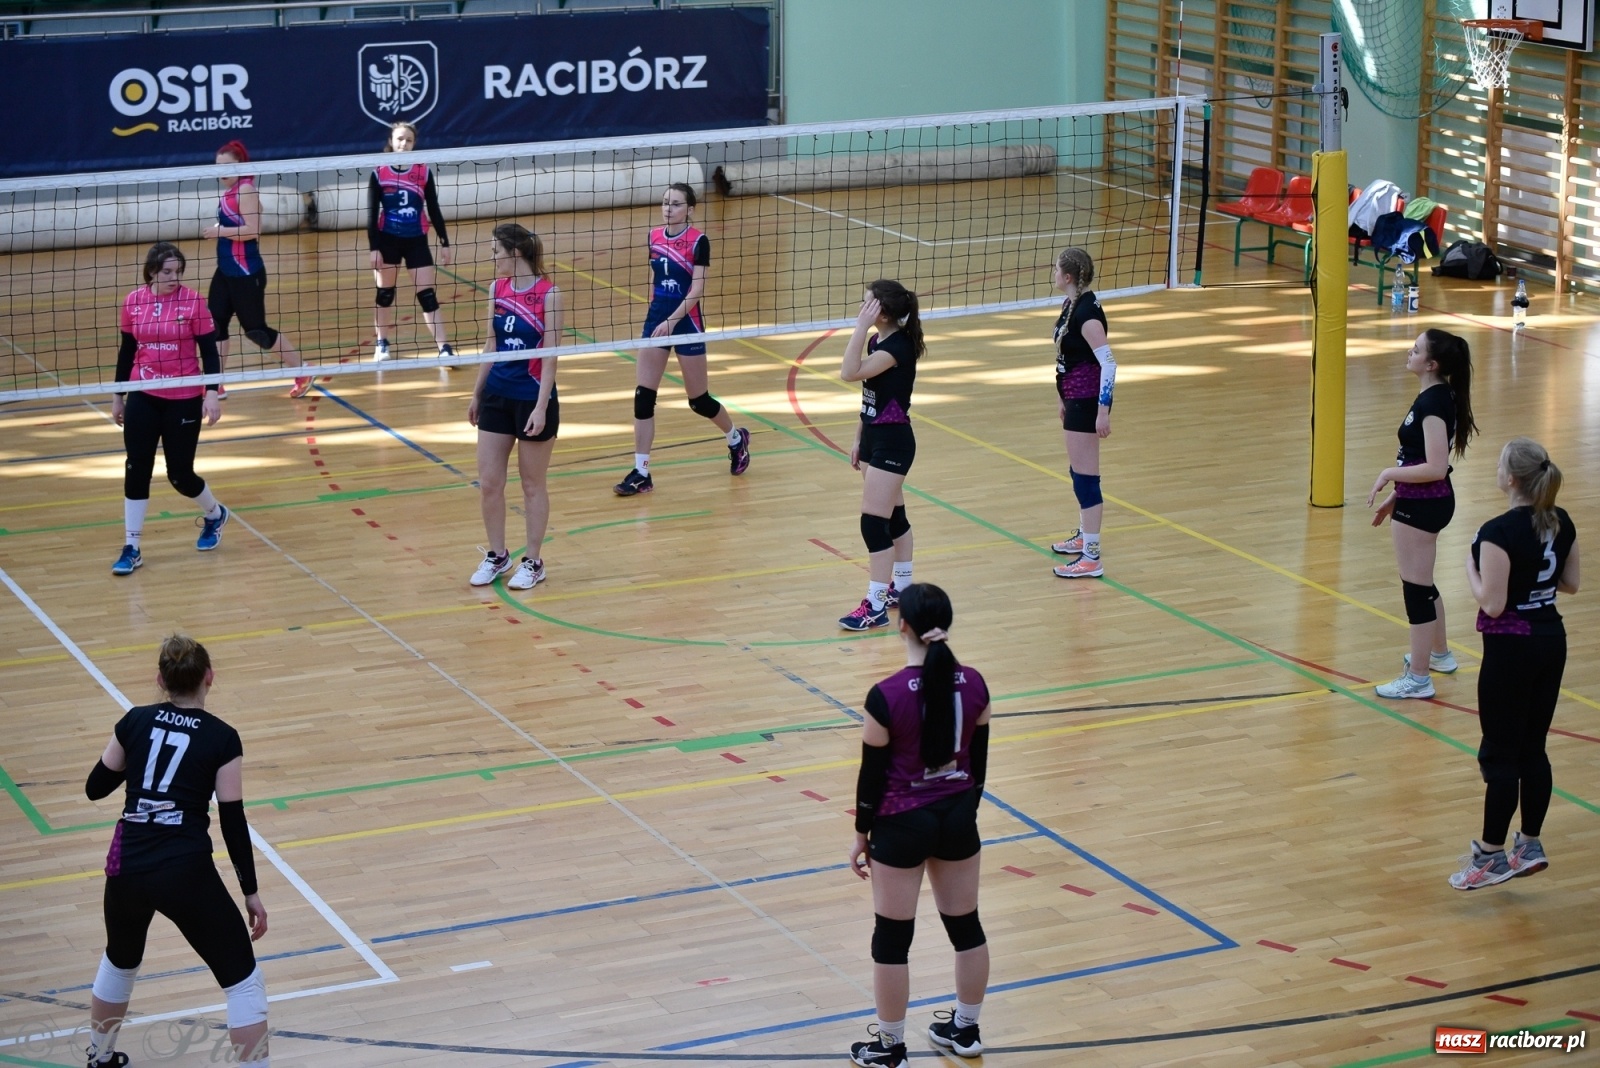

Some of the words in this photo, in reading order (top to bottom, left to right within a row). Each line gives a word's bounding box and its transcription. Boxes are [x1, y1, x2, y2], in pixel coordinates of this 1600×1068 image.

[484, 46, 708, 99] RACIBÓRZ
[109, 63, 252, 117] OSiR
[167, 112, 253, 133] RACIBÓRZ
[398, 190, 408, 206] 3
[152, 302, 162, 317] 3
[504, 315, 516, 333] 8
[146, 343, 178, 351] TAURON
[155, 709, 201, 729] ZAJONC
[142, 727, 190, 793] 17
